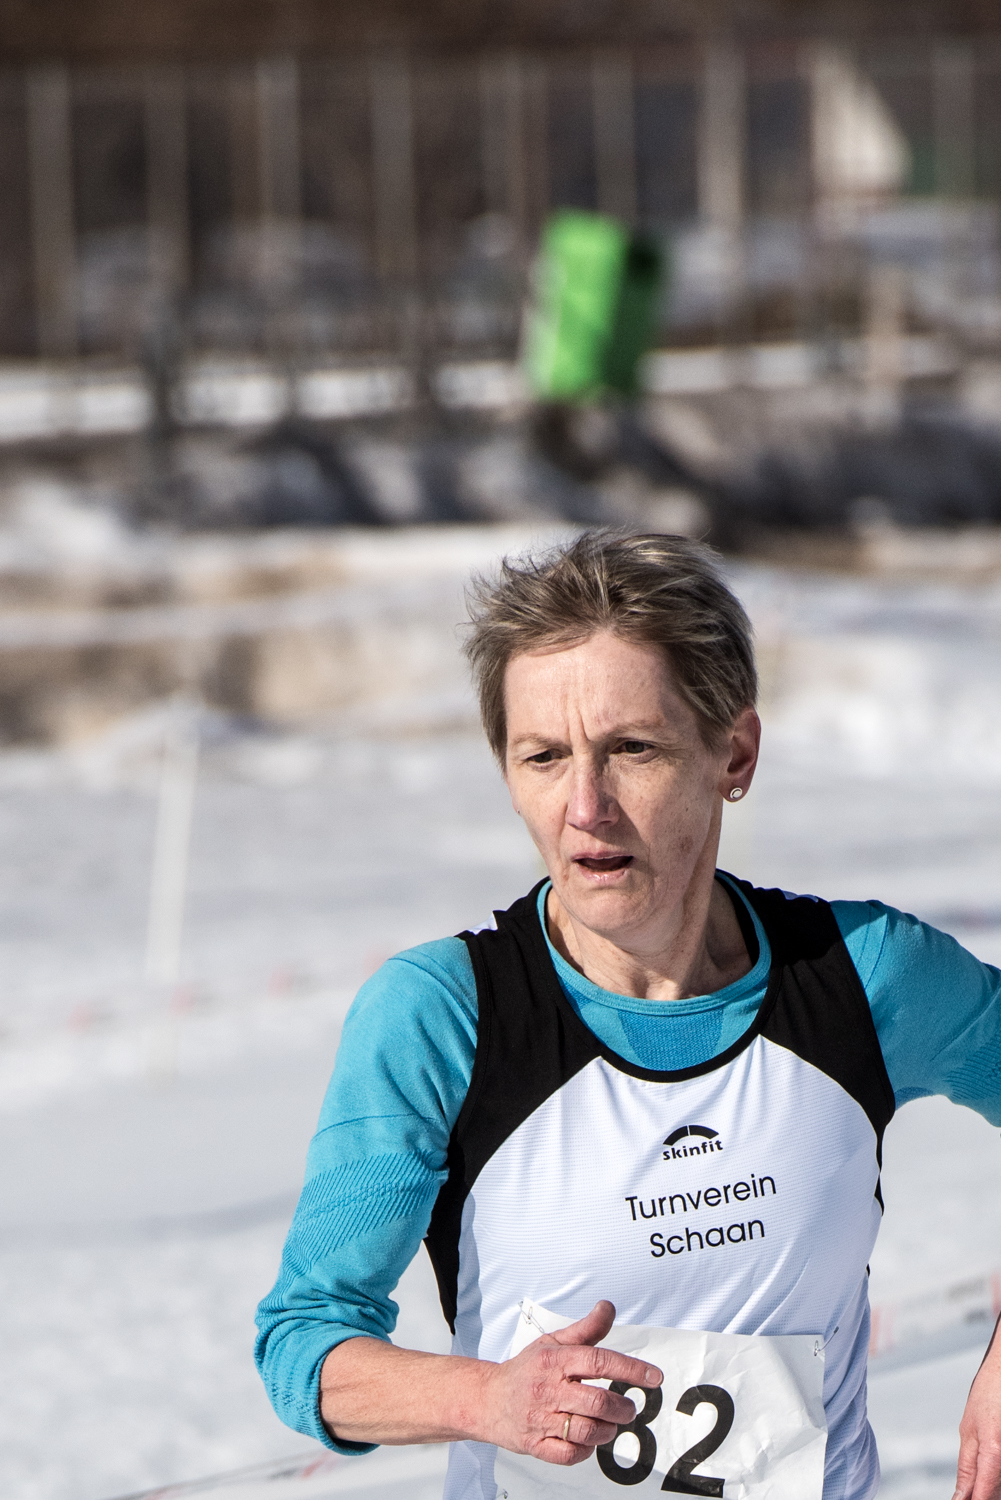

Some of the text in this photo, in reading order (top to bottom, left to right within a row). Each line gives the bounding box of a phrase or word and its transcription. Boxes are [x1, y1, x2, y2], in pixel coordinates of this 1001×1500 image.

[663, 1140, 723, 1161] skinfit
[625, 1173, 777, 1221] Turnverein
[650, 1219, 765, 1258] Schaan
[596, 1380, 735, 1498] 82
